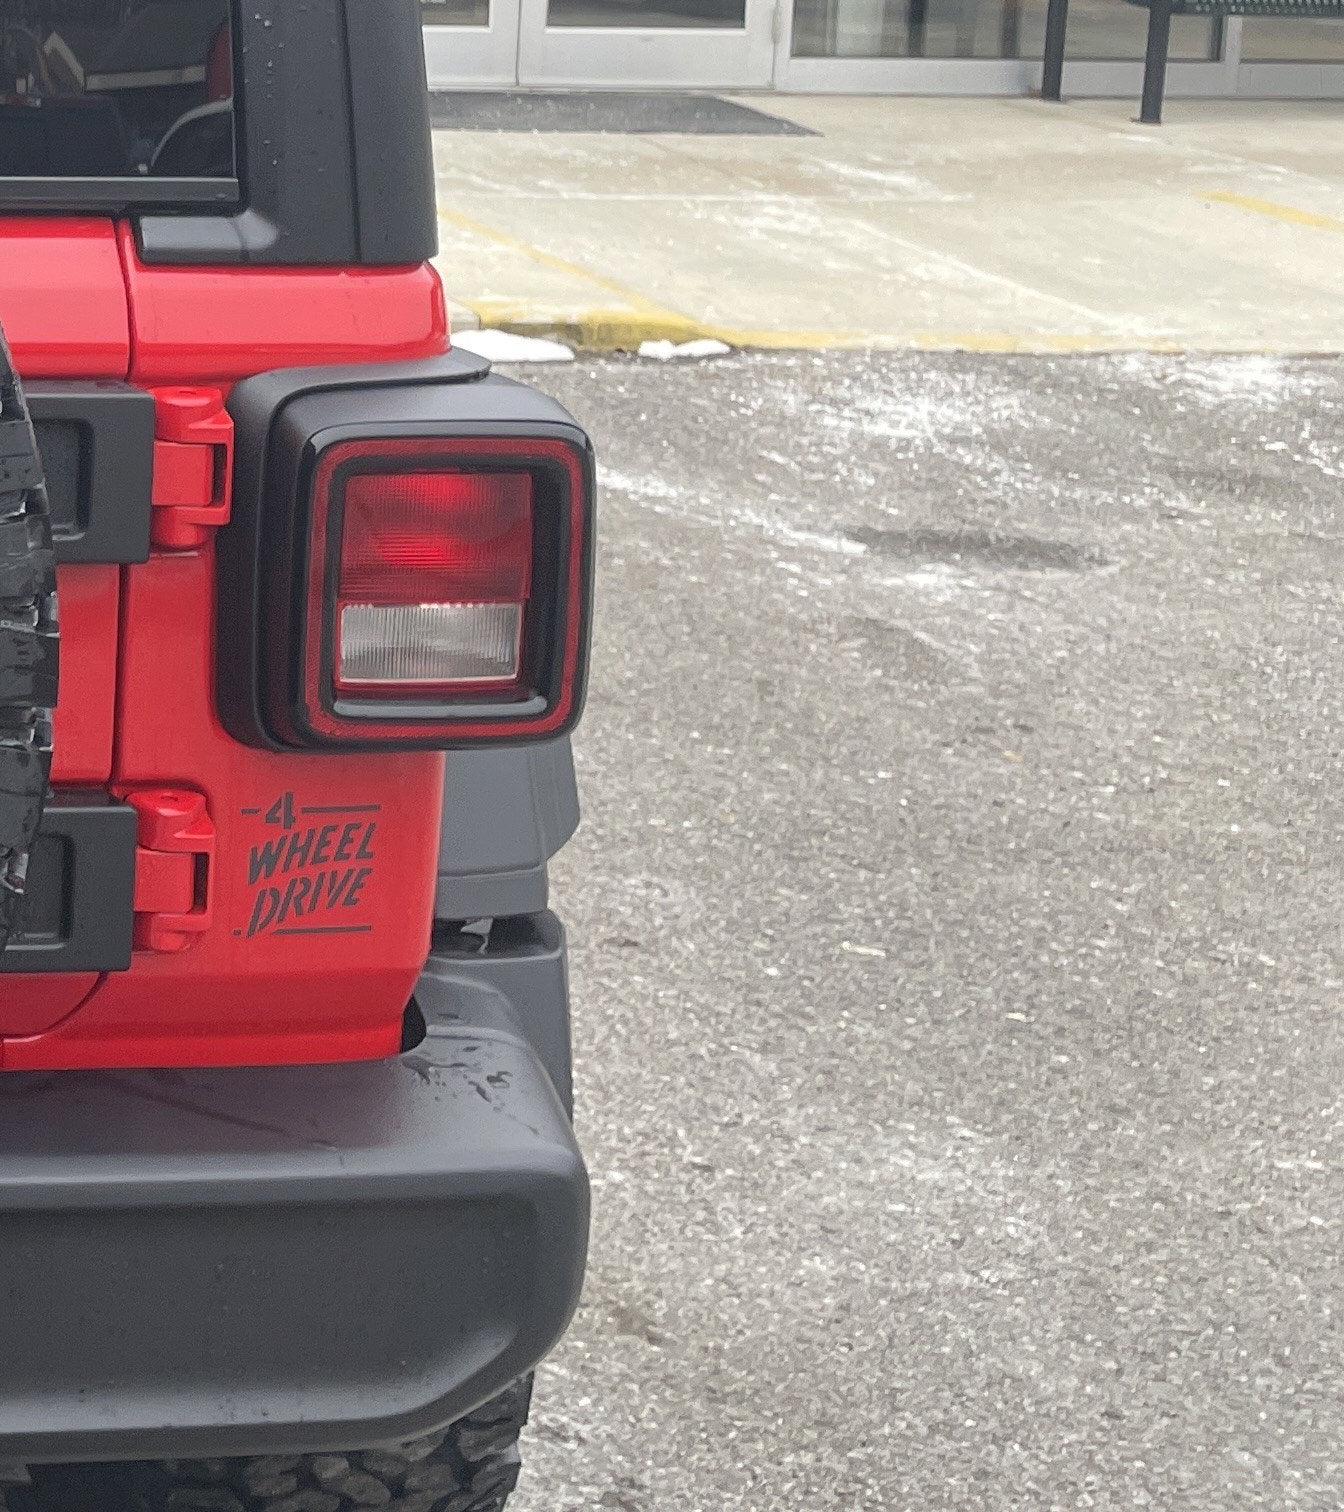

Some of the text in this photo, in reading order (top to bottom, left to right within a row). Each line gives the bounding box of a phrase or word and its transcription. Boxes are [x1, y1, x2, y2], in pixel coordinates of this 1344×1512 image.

[265, 791, 296, 829] 4
[248, 822, 377, 886] WHEEL
[246, 868, 373, 938] DRIVE
